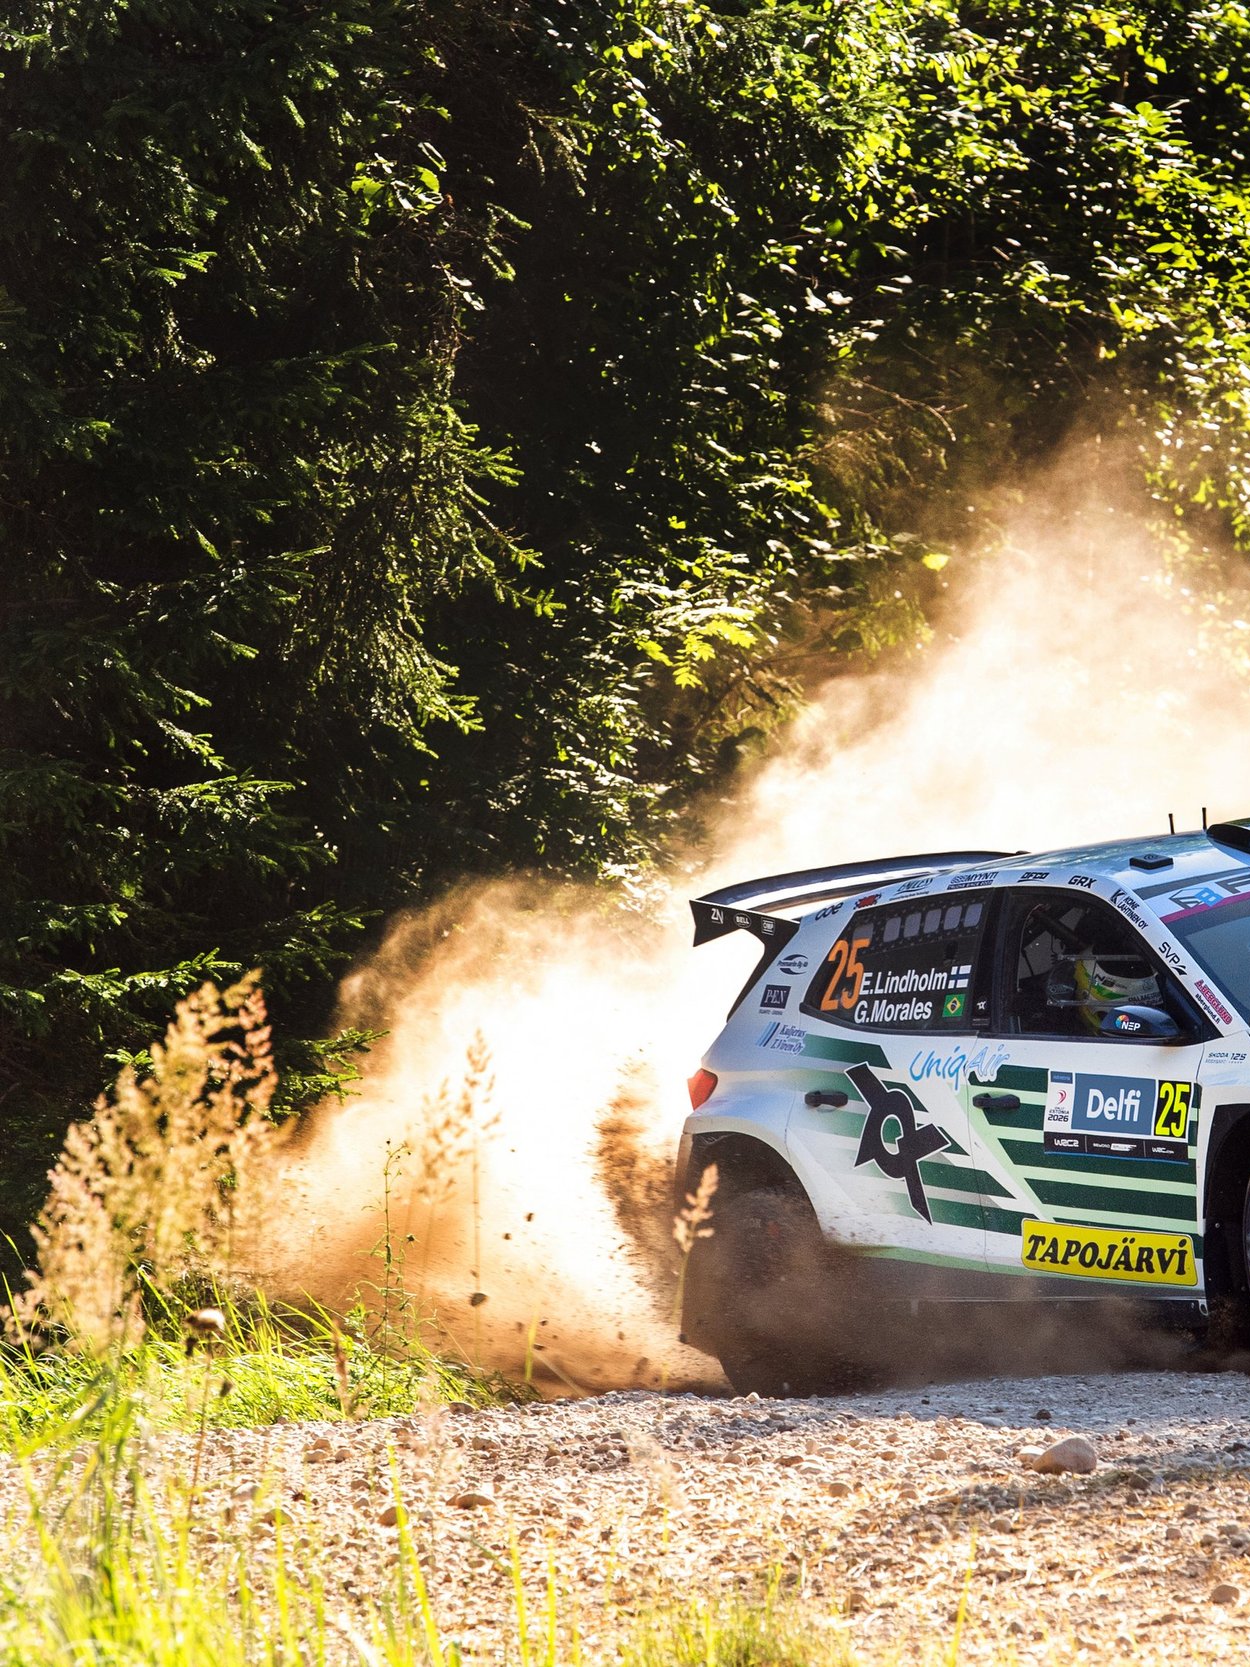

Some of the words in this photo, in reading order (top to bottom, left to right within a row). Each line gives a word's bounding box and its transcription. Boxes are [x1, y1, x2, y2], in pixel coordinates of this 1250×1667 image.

[1067, 874, 1098, 889] GRX
[735, 915, 750, 925] BELL
[1158, 941, 1181, 965] SVP
[820, 938, 871, 1012] 25
[859, 967, 949, 996] E.Lindholm
[763, 988, 787, 1004] PEN
[853, 997, 934, 1024] G.Morales
[1121, 1020, 1142, 1031] NEP
[1086, 1087, 1143, 1123] Delfi
[1154, 1081, 1192, 1138] 25
[1047, 1113, 1069, 1123] 2026
